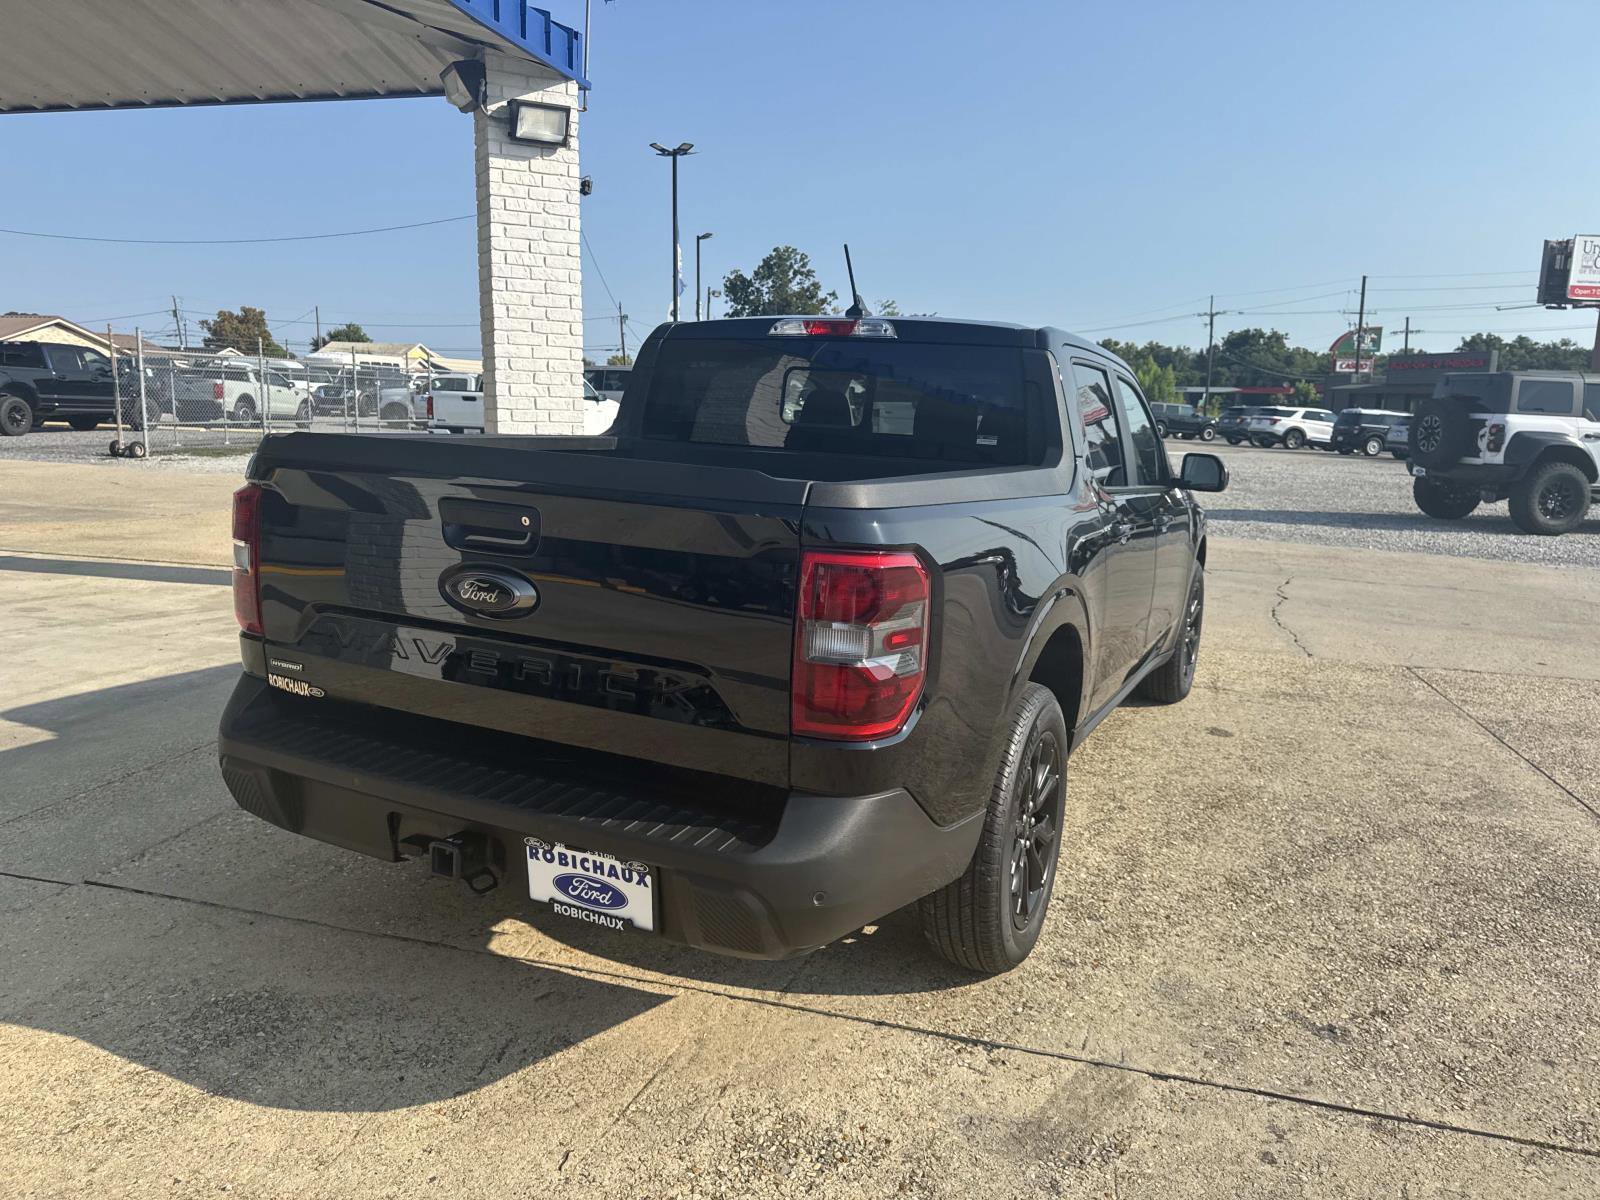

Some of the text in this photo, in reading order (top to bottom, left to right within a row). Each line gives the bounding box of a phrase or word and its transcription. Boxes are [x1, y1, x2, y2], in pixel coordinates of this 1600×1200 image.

[460, 580, 500, 603] Ford
[268, 673, 310, 697] ROBICHAUX
[316, 622, 705, 720] MAVERICK
[528, 846, 650, 889] ROBICHAUX
[568, 877, 613, 905] Ford
[553, 903, 625, 931] ROBICHAUX
